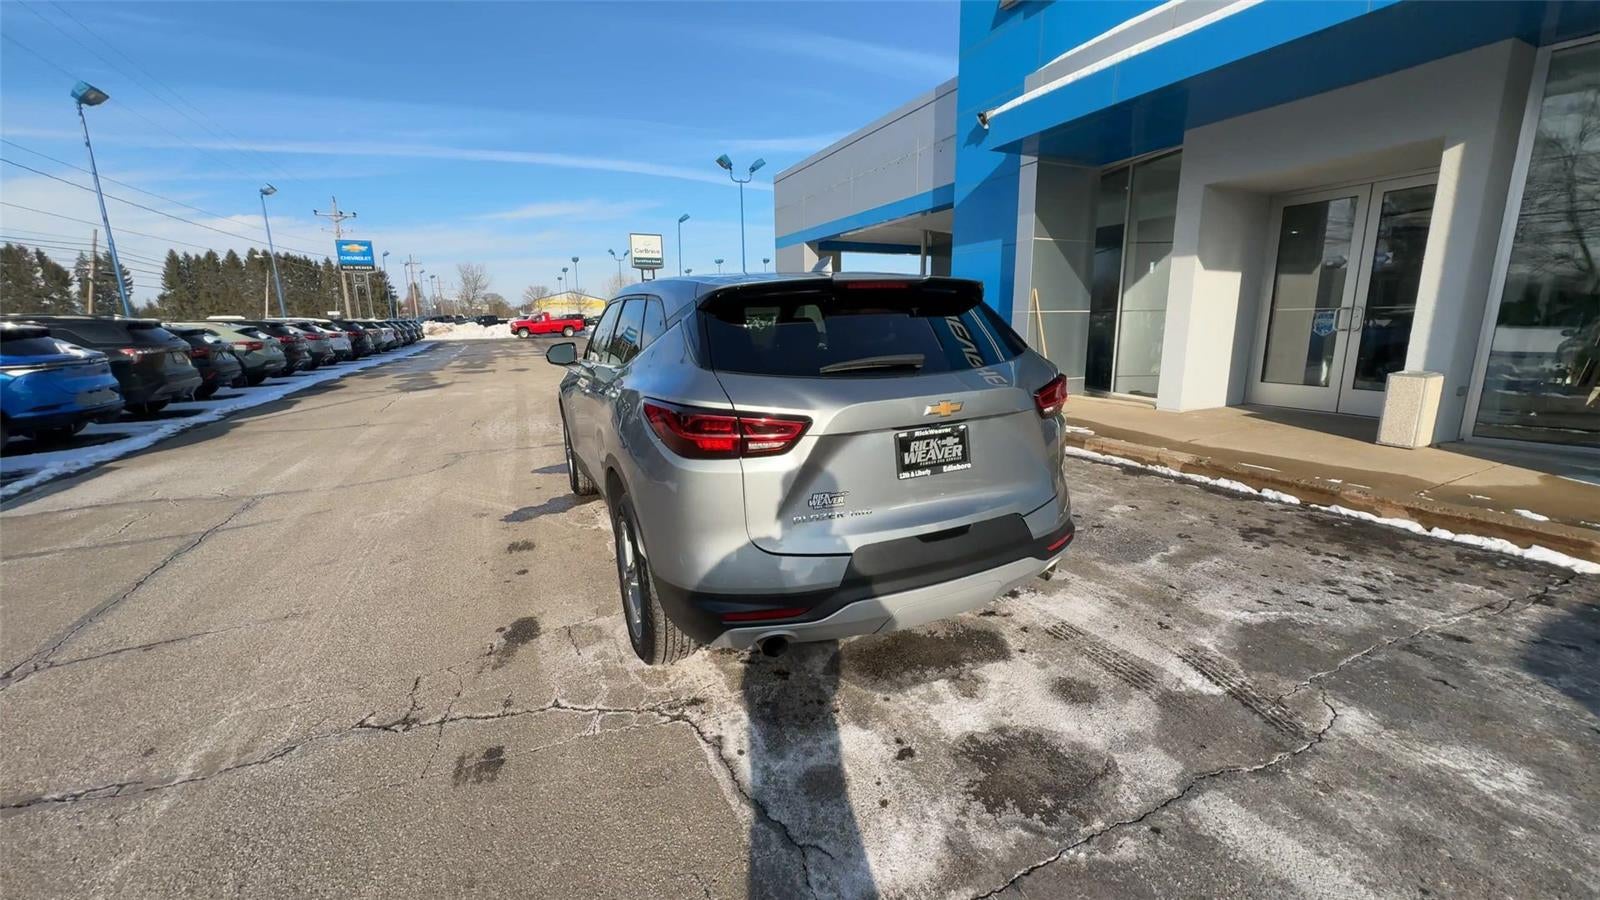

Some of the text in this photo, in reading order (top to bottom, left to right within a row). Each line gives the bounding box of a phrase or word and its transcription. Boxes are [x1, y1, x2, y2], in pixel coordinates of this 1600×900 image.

[910, 438, 939, 452] RICK
[904, 444, 963, 465] WEAVER
[808, 496, 845, 507] WEAVER
